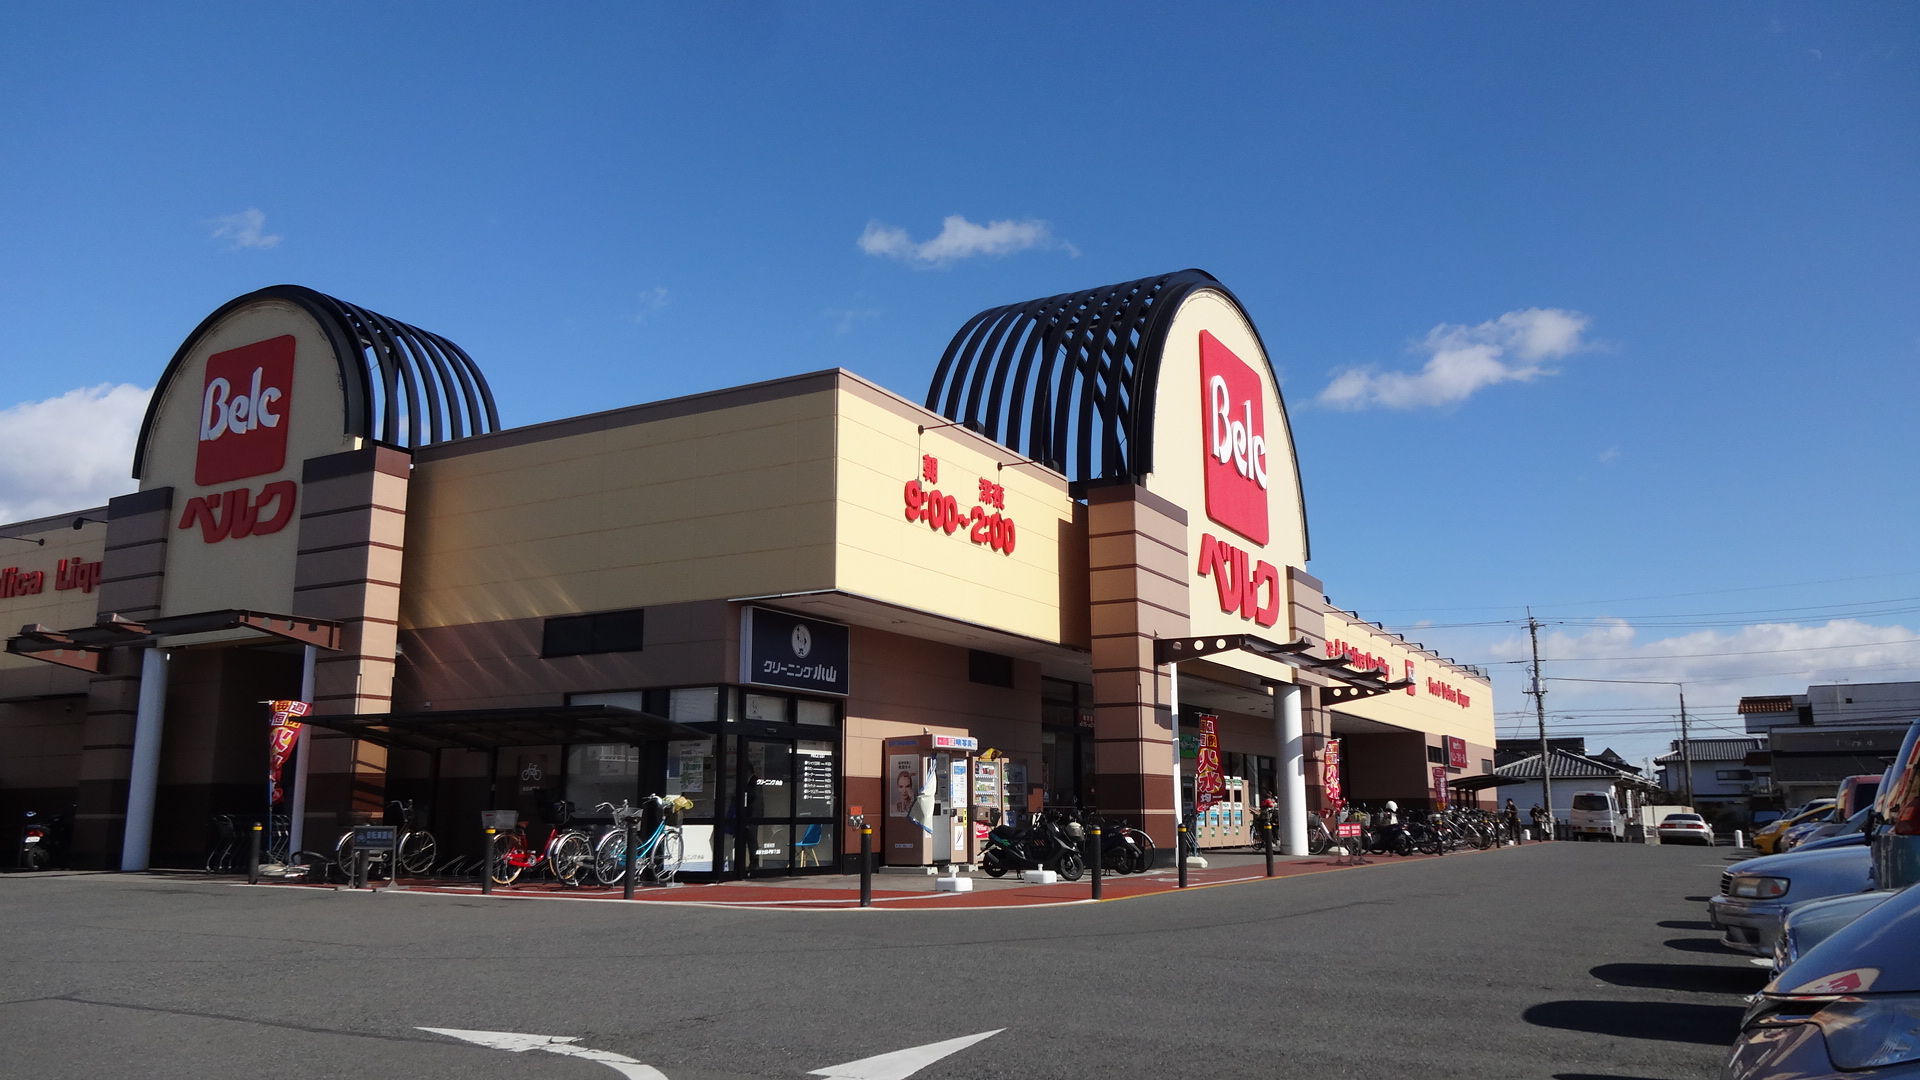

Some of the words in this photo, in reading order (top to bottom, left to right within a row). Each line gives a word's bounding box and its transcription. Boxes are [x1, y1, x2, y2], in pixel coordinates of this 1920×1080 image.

[200, 366, 282, 441] Belc
[1210, 375, 1268, 489] Belc
[922, 454, 938, 485] 朝
[979, 477, 1005, 511] 深夜
[178, 480, 297, 544] ベルク
[1198, 533, 1280, 626] ベルク
[764, 660, 837, 683] クリーニング小山
